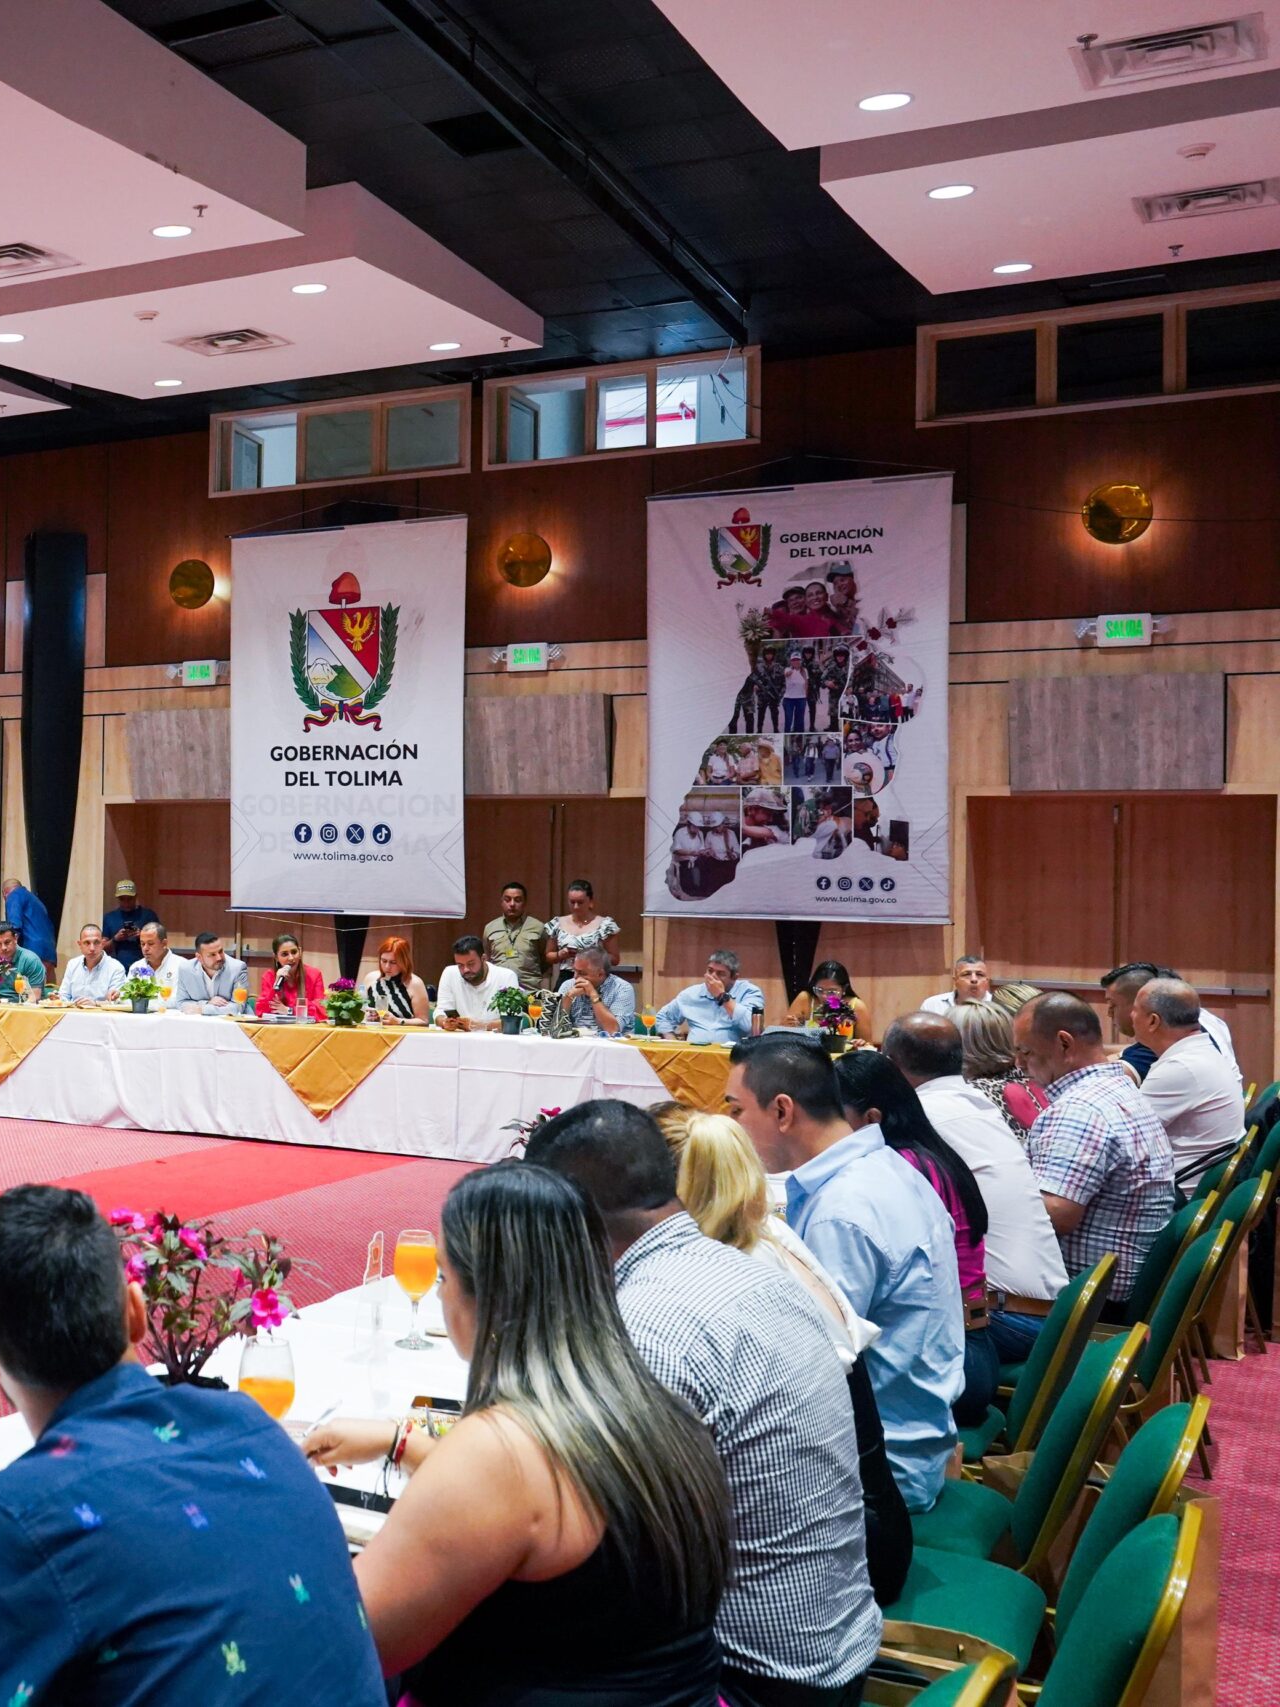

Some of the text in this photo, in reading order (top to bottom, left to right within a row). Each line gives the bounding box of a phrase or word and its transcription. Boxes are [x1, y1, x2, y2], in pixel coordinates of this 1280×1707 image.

[780, 525, 884, 544] GOBERNACIÓN
[790, 544, 873, 558] DEL TOLIMA
[1105, 619, 1144, 639] SALIDA
[270, 739, 419, 762] GOBERNACIÓN
[284, 770, 403, 787] DEL TOLIMA
[293, 851, 394, 863] www.tolima.gov.co
[815, 896, 897, 904] www.tolima.gov.co
